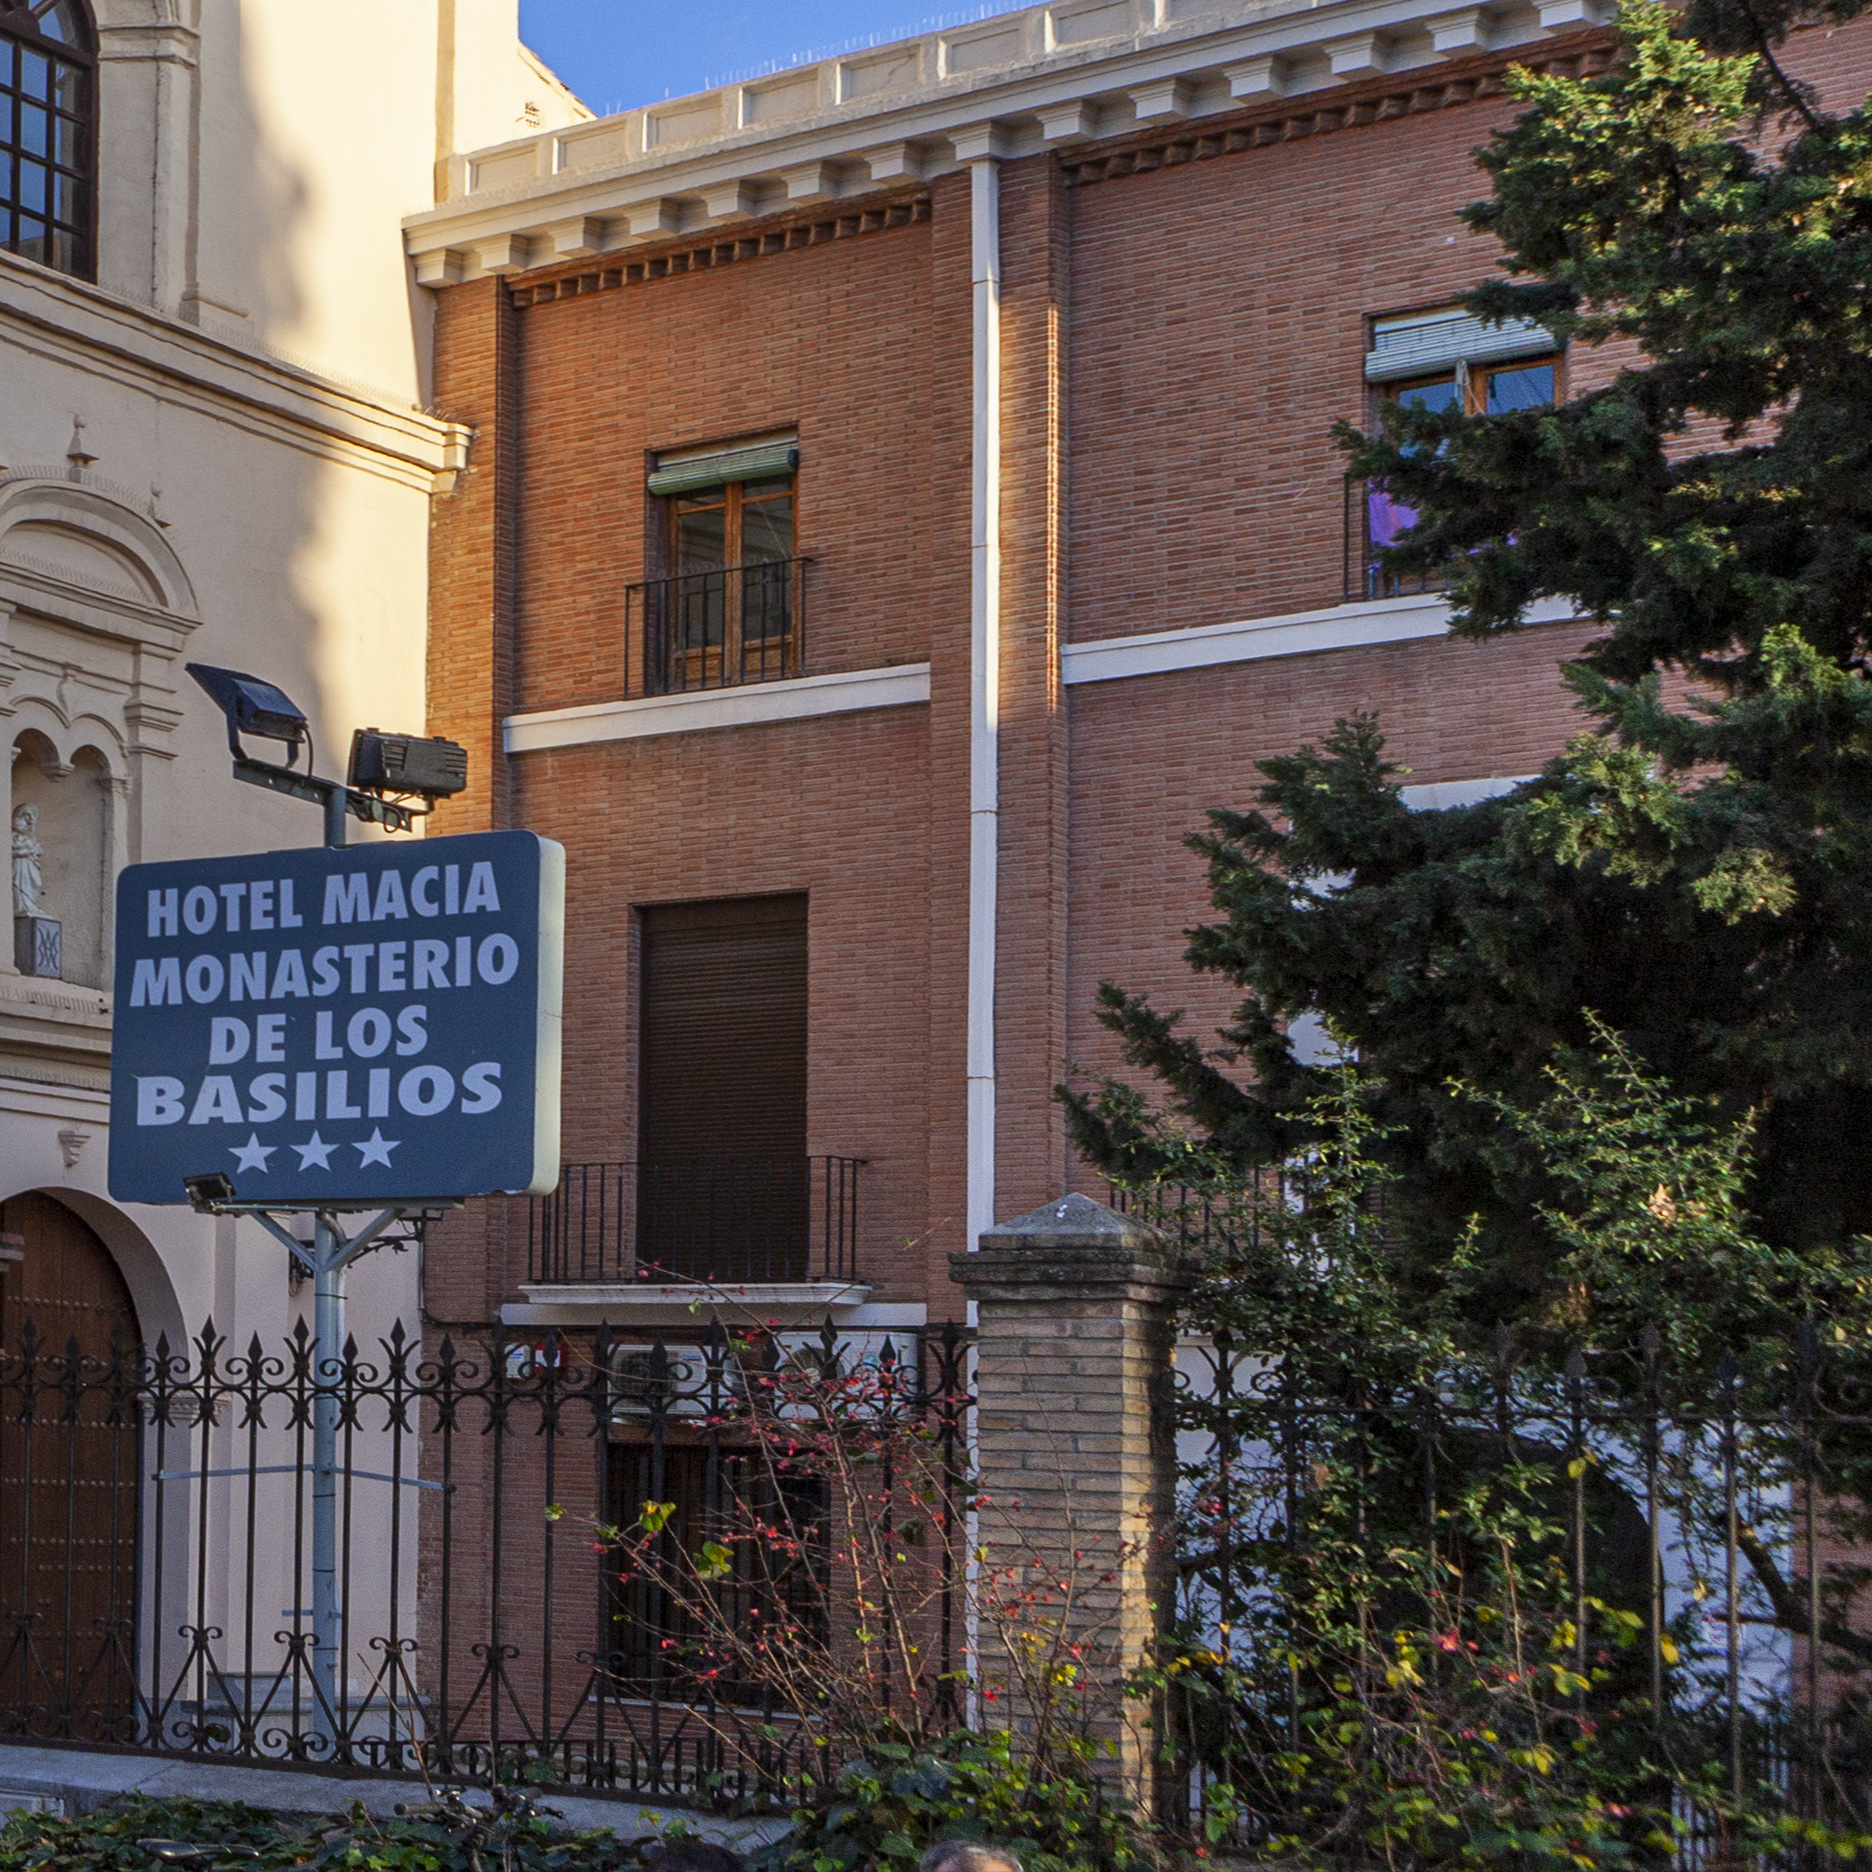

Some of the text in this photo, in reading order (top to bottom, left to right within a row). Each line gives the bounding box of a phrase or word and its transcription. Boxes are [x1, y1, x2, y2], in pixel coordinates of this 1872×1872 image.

[146, 861, 501, 938] HOTEL MACIA
[129, 932, 520, 1007] MONASTERIO
[208, 1004, 429, 1065] DE LOS
[136, 1062, 503, 1126] BASILIOS
